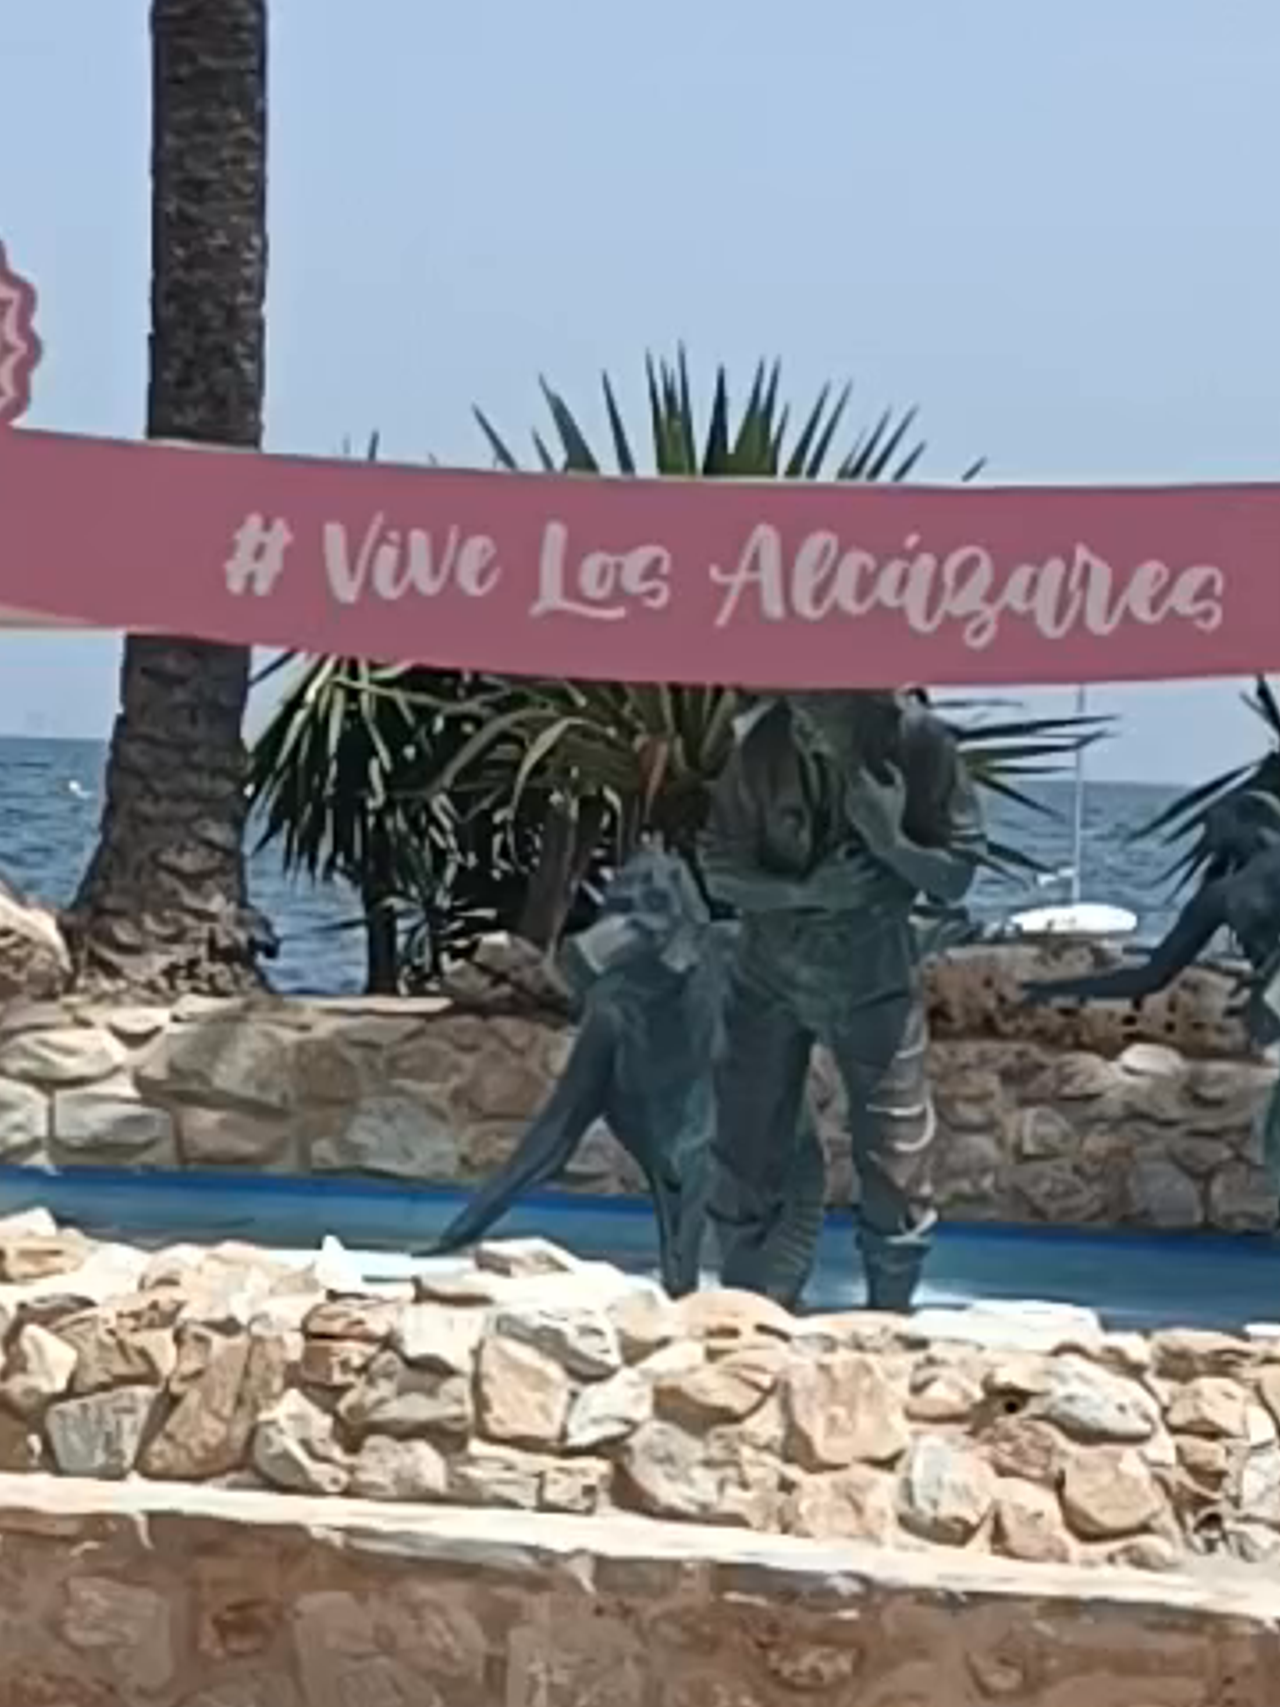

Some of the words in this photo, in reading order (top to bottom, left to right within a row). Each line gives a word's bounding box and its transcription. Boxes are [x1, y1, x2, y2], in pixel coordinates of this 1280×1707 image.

[322, 512, 501, 603] Vive
[529, 521, 671, 619] Los
[709, 522, 1224, 649] Alcázares
